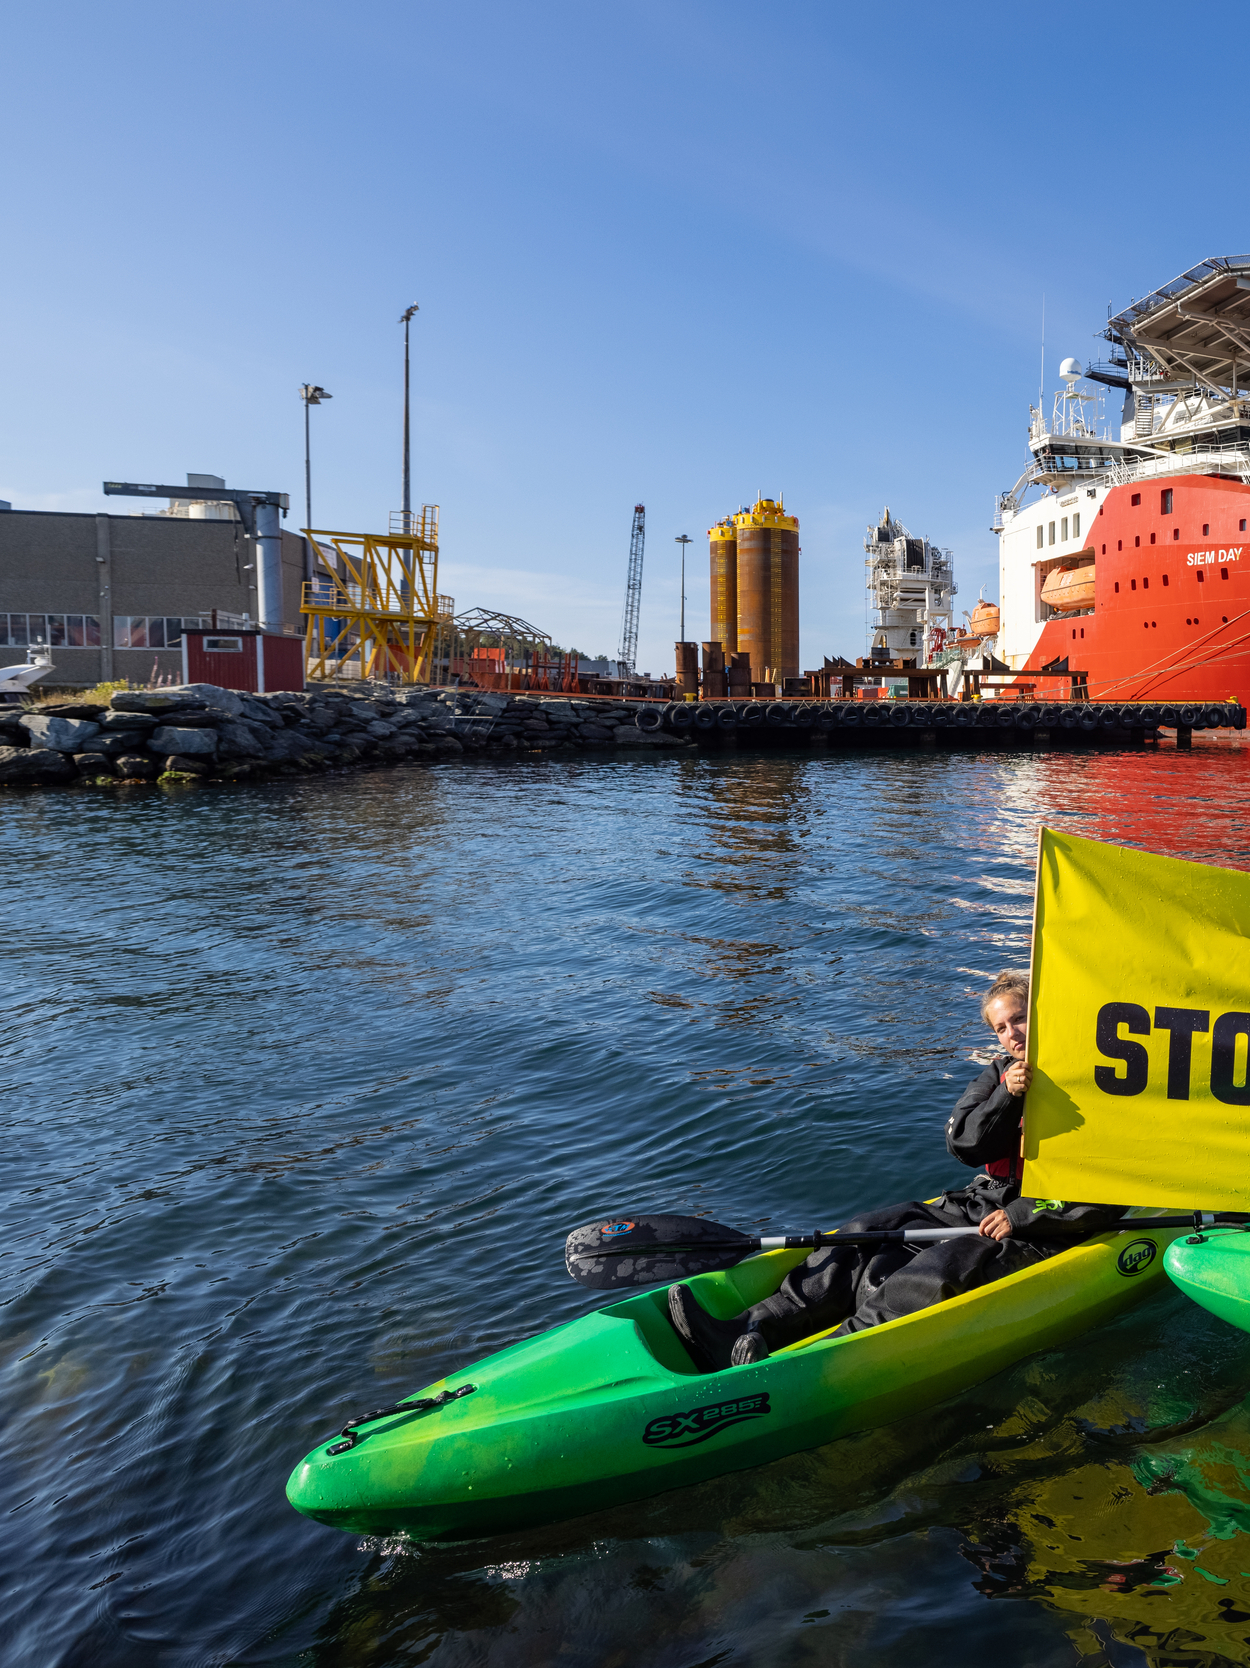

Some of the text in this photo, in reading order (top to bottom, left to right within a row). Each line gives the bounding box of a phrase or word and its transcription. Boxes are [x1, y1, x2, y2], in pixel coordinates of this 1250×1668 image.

[1186, 547, 1243, 567] SIEM DAY
[1120, 1244, 1156, 1270] dag
